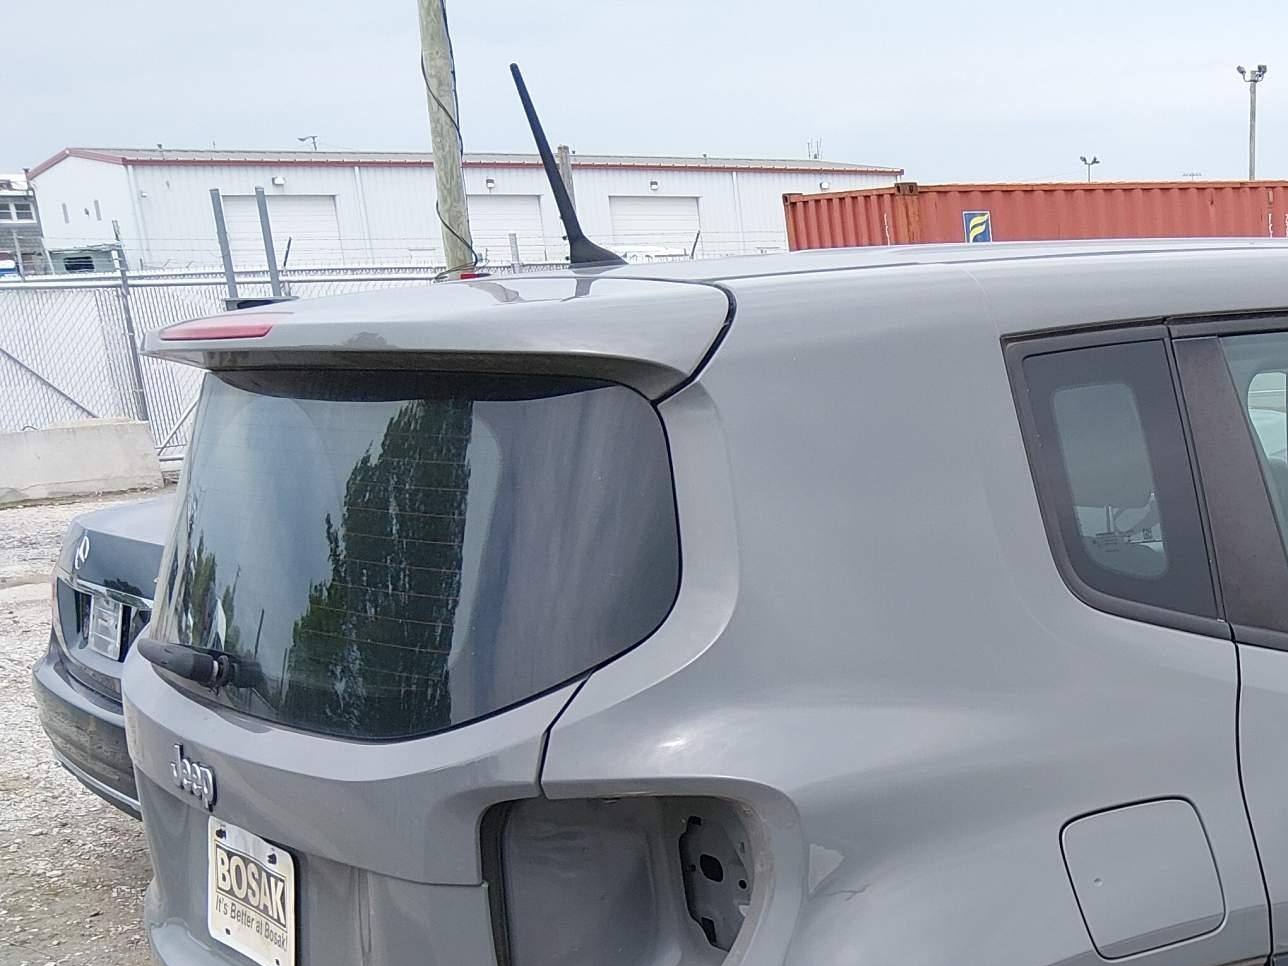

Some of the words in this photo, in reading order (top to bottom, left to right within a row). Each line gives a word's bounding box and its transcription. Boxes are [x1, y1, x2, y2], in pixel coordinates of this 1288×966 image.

[170, 743, 216, 811] Jeep
[216, 847, 287, 926] BOSAK
[215, 895, 229, 916] It's
[230, 903, 255, 930] Better
[255, 919, 263, 936] at
[264, 922, 289, 952] Bosak!
